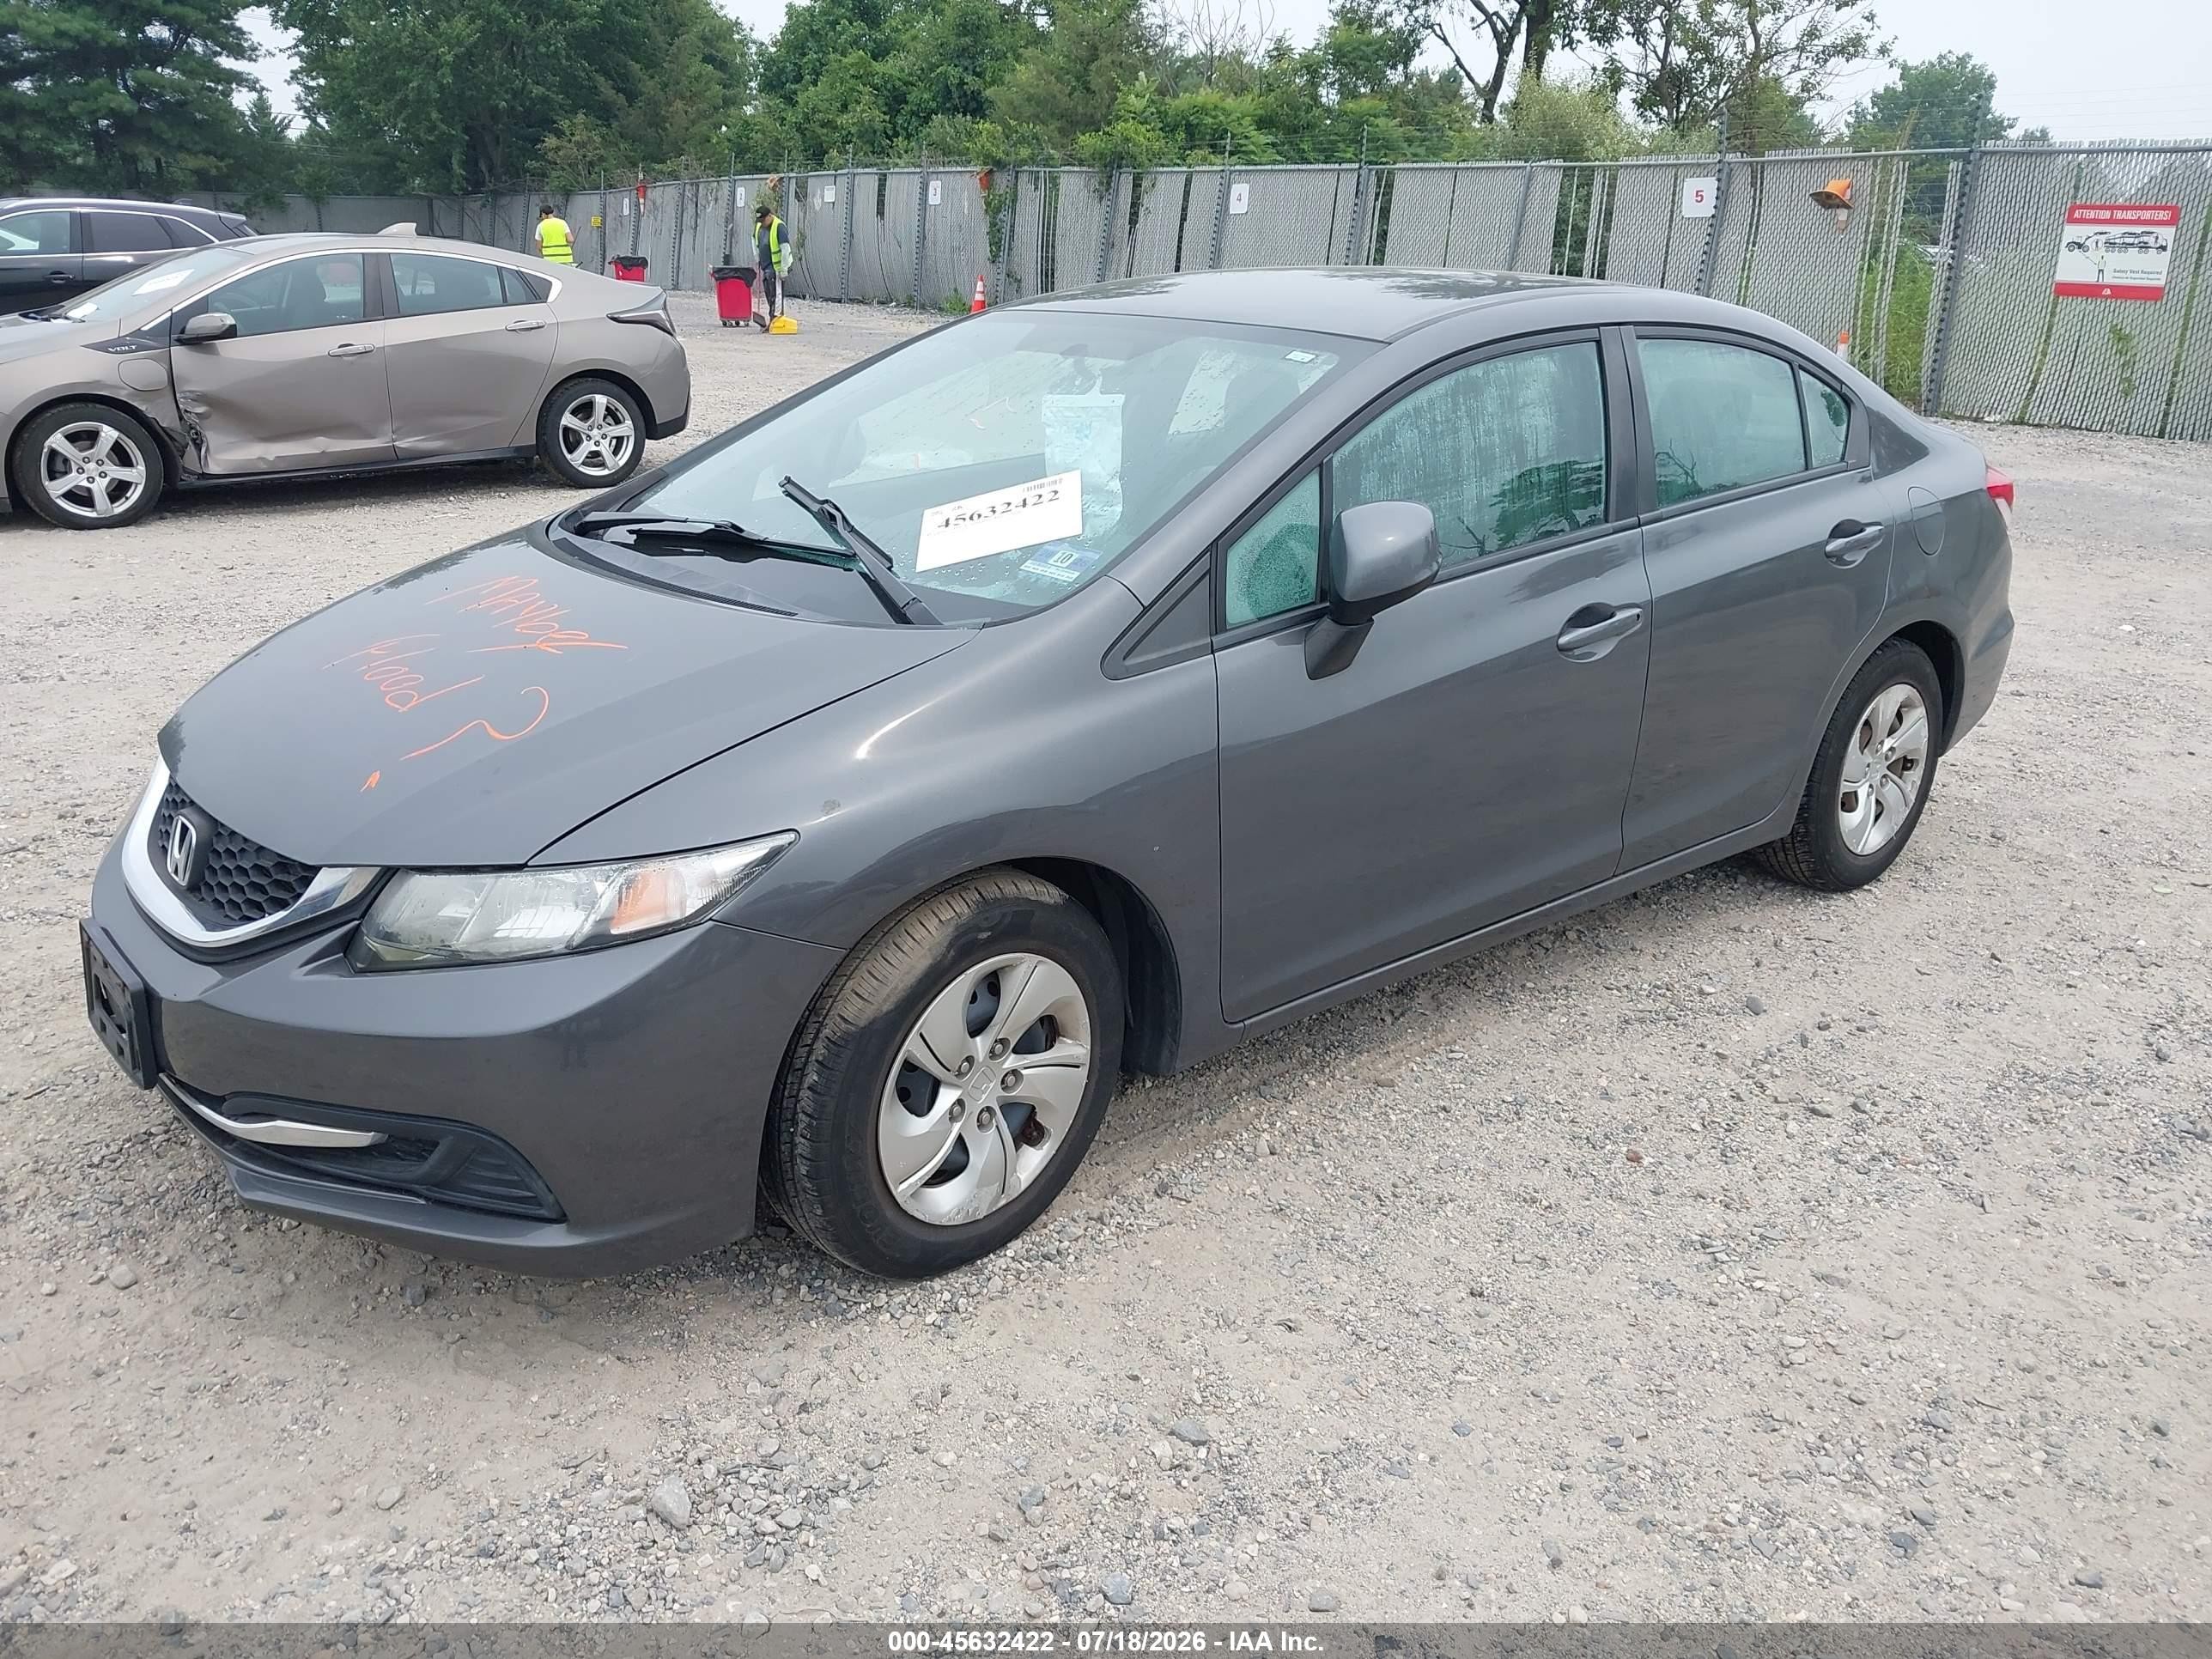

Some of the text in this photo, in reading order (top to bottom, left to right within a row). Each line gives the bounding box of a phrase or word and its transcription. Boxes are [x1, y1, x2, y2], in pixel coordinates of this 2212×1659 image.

[1236, 192, 1243, 202] 4
[1695, 189, 1705, 204] 5
[2073, 209, 2172, 221] ATTENTION TRANSPORTERS!
[937, 489, 1060, 529] 45632422
[1053, 551, 1074, 564] 10
